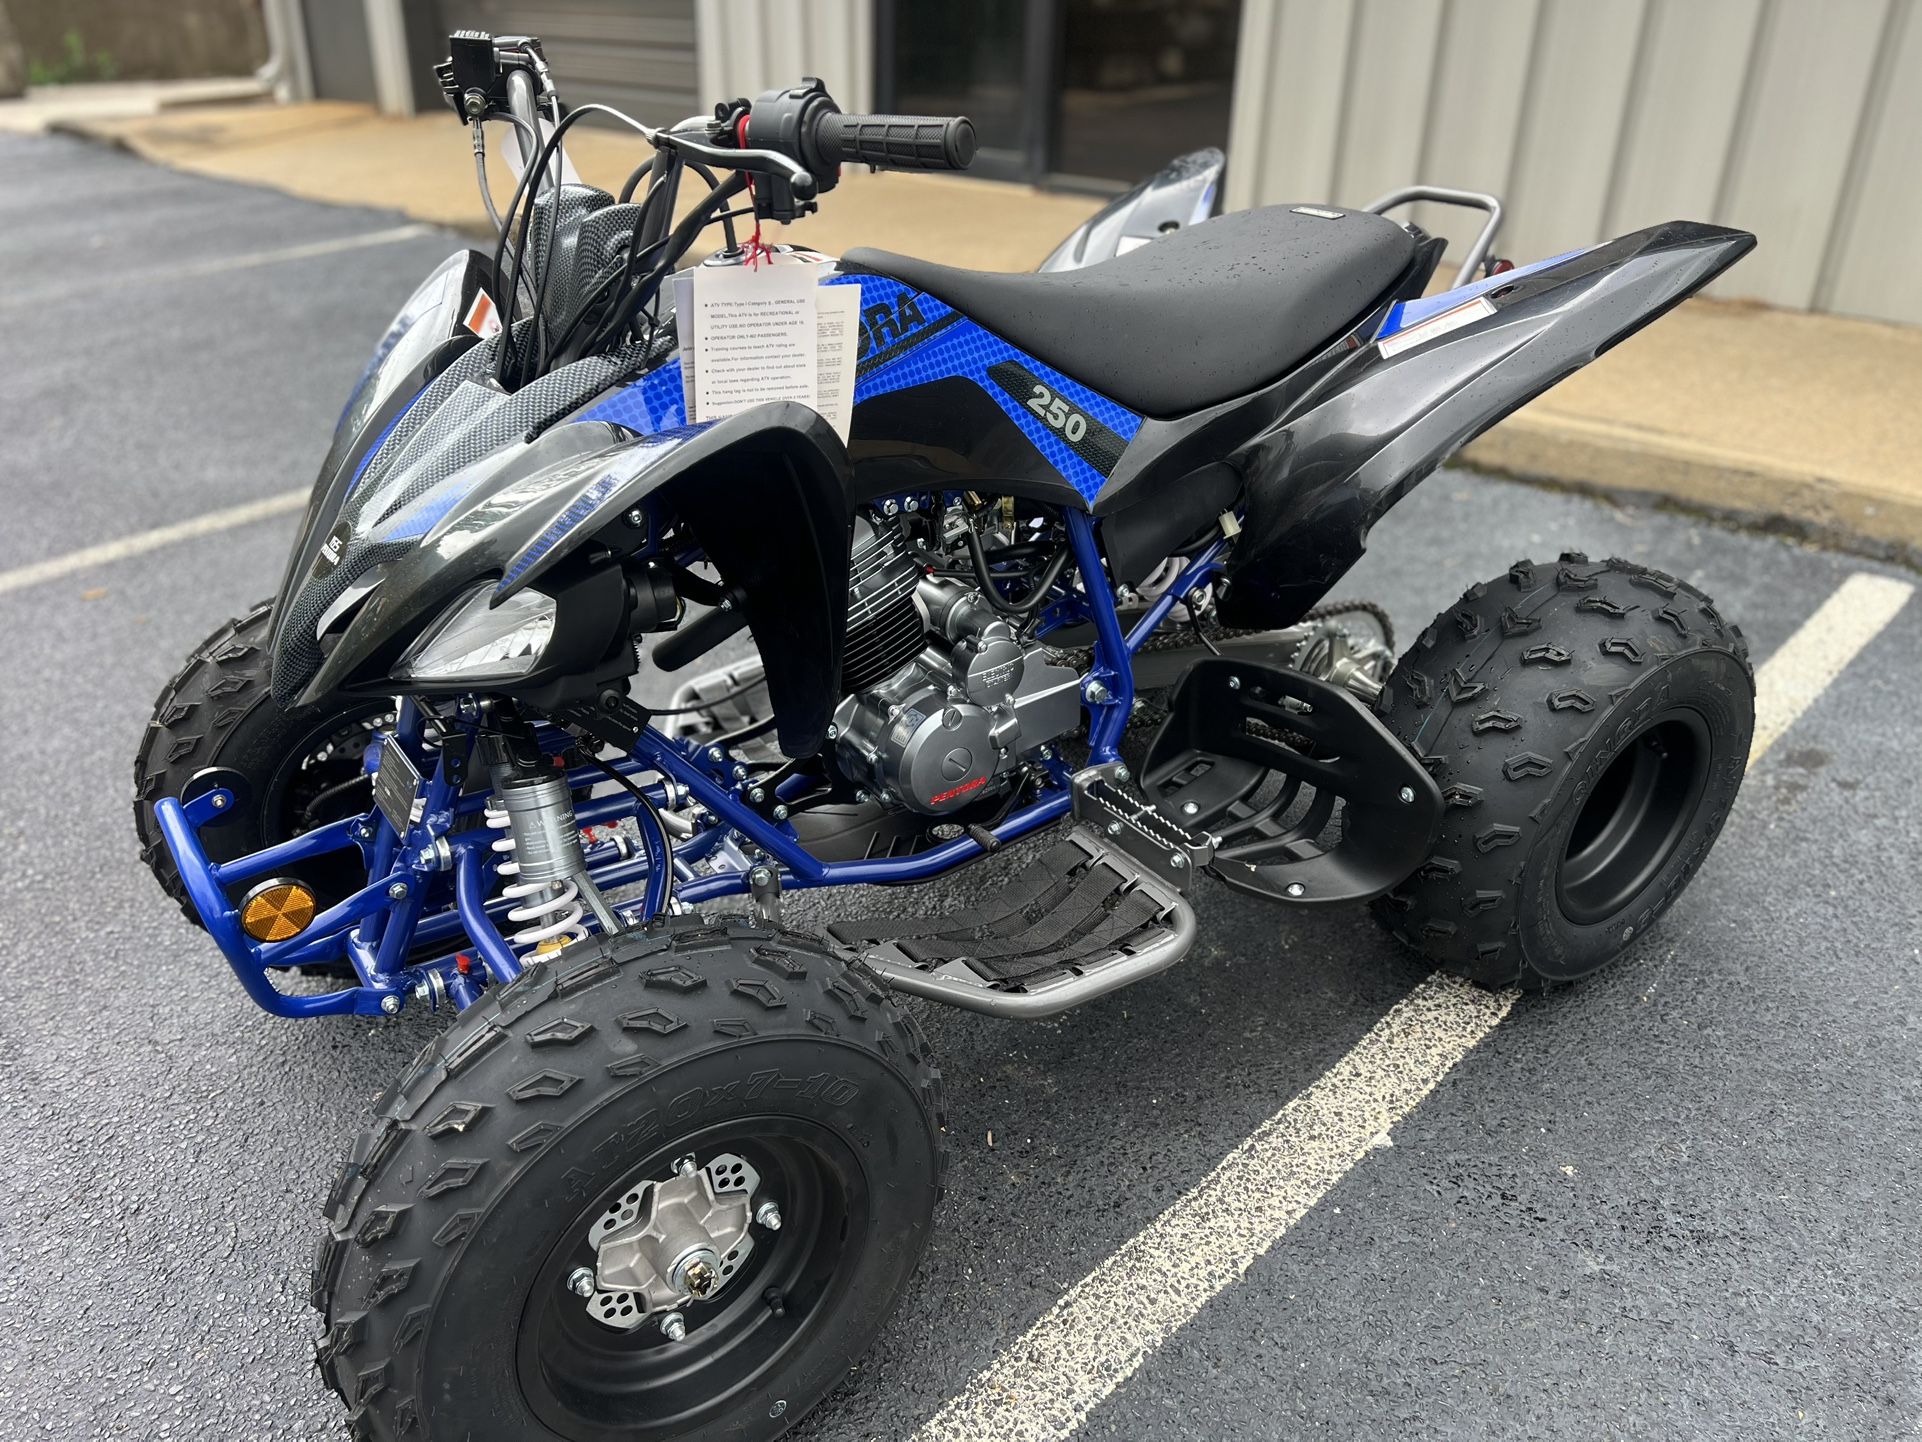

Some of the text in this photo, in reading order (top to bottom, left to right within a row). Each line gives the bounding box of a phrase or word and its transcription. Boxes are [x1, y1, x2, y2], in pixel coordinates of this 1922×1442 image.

[1027, 385, 1087, 442] 250
[930, 777, 987, 805] PENTORA
[536, 809, 573, 828] WNING
